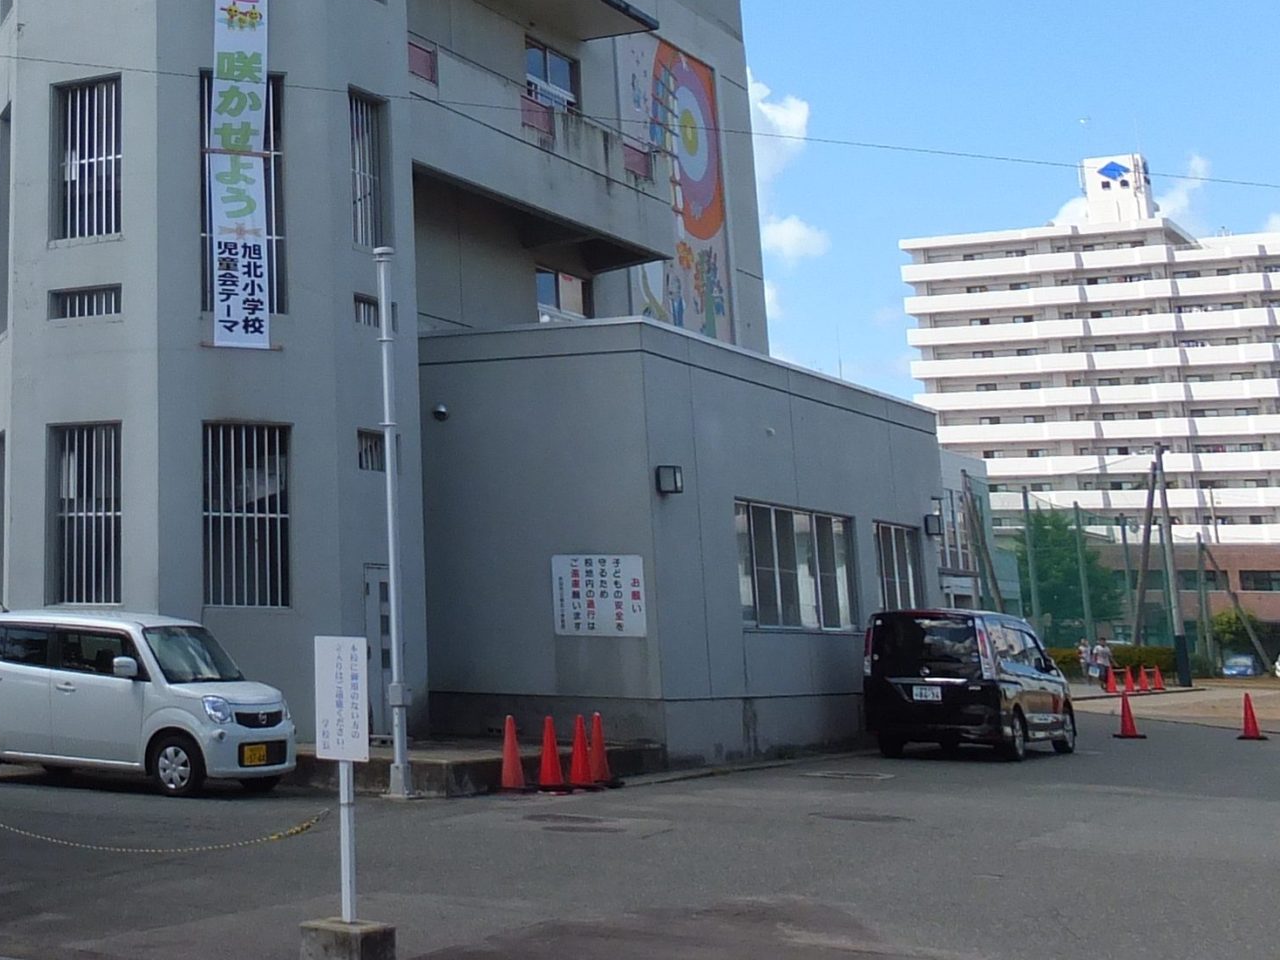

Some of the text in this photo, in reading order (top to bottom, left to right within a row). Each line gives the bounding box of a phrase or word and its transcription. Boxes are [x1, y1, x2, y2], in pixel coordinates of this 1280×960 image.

[214, 51, 262, 219] 咲かせよう
[218, 241, 240, 333] 児童会テーマ
[241, 243, 264, 335] 旭北小学校
